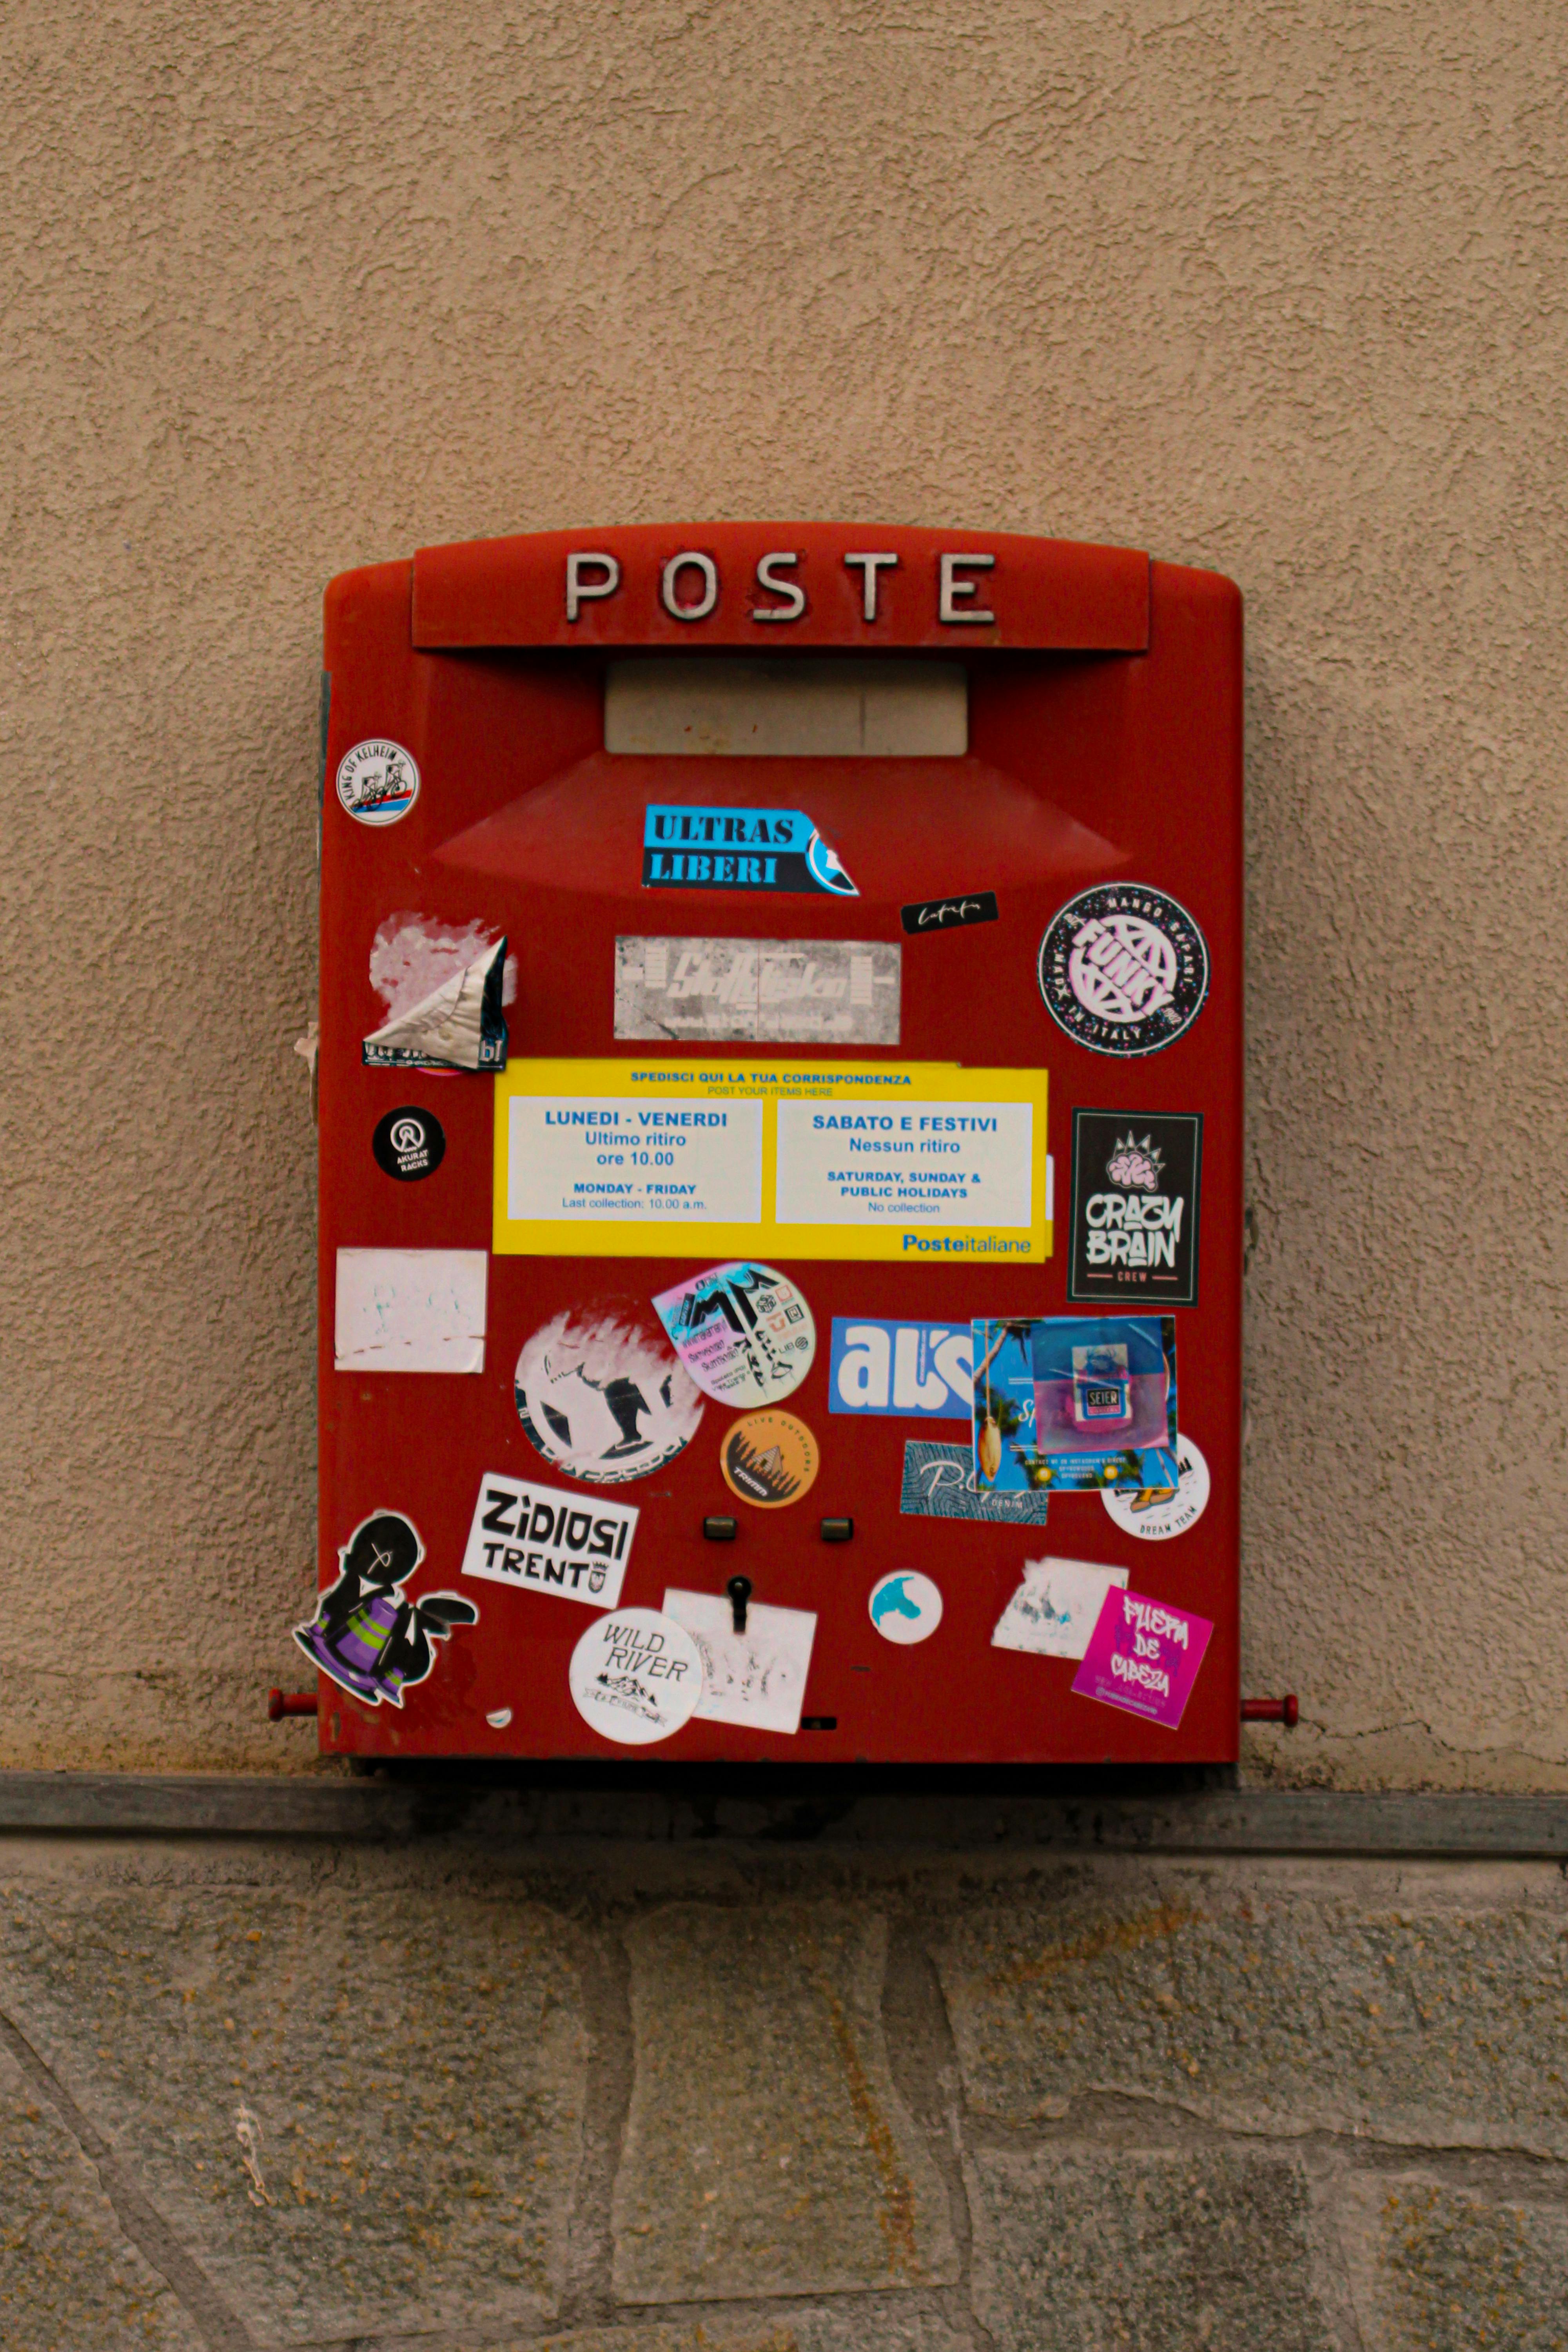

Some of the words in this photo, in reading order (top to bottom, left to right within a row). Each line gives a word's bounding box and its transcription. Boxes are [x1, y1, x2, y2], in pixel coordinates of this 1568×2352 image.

[567, 552, 995, 622] POSTE
[355, 744, 397, 762] KELHEIM
[345, 758, 357, 773] OF
[342, 775, 355, 800] KING
[654, 814, 794, 844] ULTRAS
[650, 853, 778, 884] LIBERI
[1107, 897, 1163, 918] MANGO
[1169, 921, 1195, 984] SAFARI
[1072, 918, 1175, 1017] FUNKY
[1068, 1005, 1085, 1023] IN
[1092, 1023, 1142, 1040] ITALY
[631, 1072, 693, 1082] SPEDISCI
[699, 1073, 723, 1082] QUI
[728, 1073, 745, 1082] LA
[750, 1074, 777, 1083] TUA
[782, 1074, 911, 1085] CORRISPONDENZA
[708, 1087, 736, 1095] POST
[739, 1087, 768, 1096] YOUR
[771, 1087, 801, 1096] ITEMS
[805, 1088, 833, 1096] HERE
[545, 1111, 619, 1126] LUNEDI
[638, 1112, 727, 1127] VENERDI
[813, 1115, 893, 1131] SABATO
[901, 1116, 912, 1131] E
[919, 1117, 997, 1132] FESTIVI
[585, 1131, 640, 1145] Ultimo
[646, 1132, 686, 1146] ritiro
[849, 1138, 913, 1152] Nessun
[920, 1139, 960, 1153] ritiro
[397, 1149, 428, 1165] AKURAT
[597, 1154, 624, 1165] ore
[631, 1152, 674, 1166] 10.00
[400, 1159, 428, 1172] RACKS
[827, 1171, 904, 1184] SATURDAY,
[909, 1172, 965, 1183] SUNDAY
[971, 1173, 981, 1183] &
[574, 1183, 633, 1194] MONDAY
[646, 1184, 696, 1195] FRIDAY
[841, 1187, 892, 1197] PUBLIC
[898, 1187, 968, 1198] HOLIDAYS
[563, 1198, 586, 1209] Last
[589, 1198, 644, 1209] collection:
[649, 1199, 679, 1209] 10.00
[682, 1201, 707, 1210] a.m.
[868, 1202, 884, 1212] No
[887, 1202, 940, 1213] collection
[1085, 1193, 1184, 1243] CRAZY
[902, 1234, 1031, 1253] Posteitaliane
[1086, 1230, 1176, 1268] BRAIN
[1117, 1271, 1147, 1283] CREW
[1089, 1390, 1117, 1406] SEIER
[747, 1416, 773, 1427] LIVE
[781, 1420, 811, 1472] OUTDOORS
[991, 1499, 1023, 1508] DENIM
[1140, 1523, 1172, 1535] DREAM
[1174, 1505, 1198, 1528] TEAM
[603, 1623, 665, 1653] WILD
[1132, 1633, 1160, 1660] DE
[605, 1646, 689, 1682] RIVER
